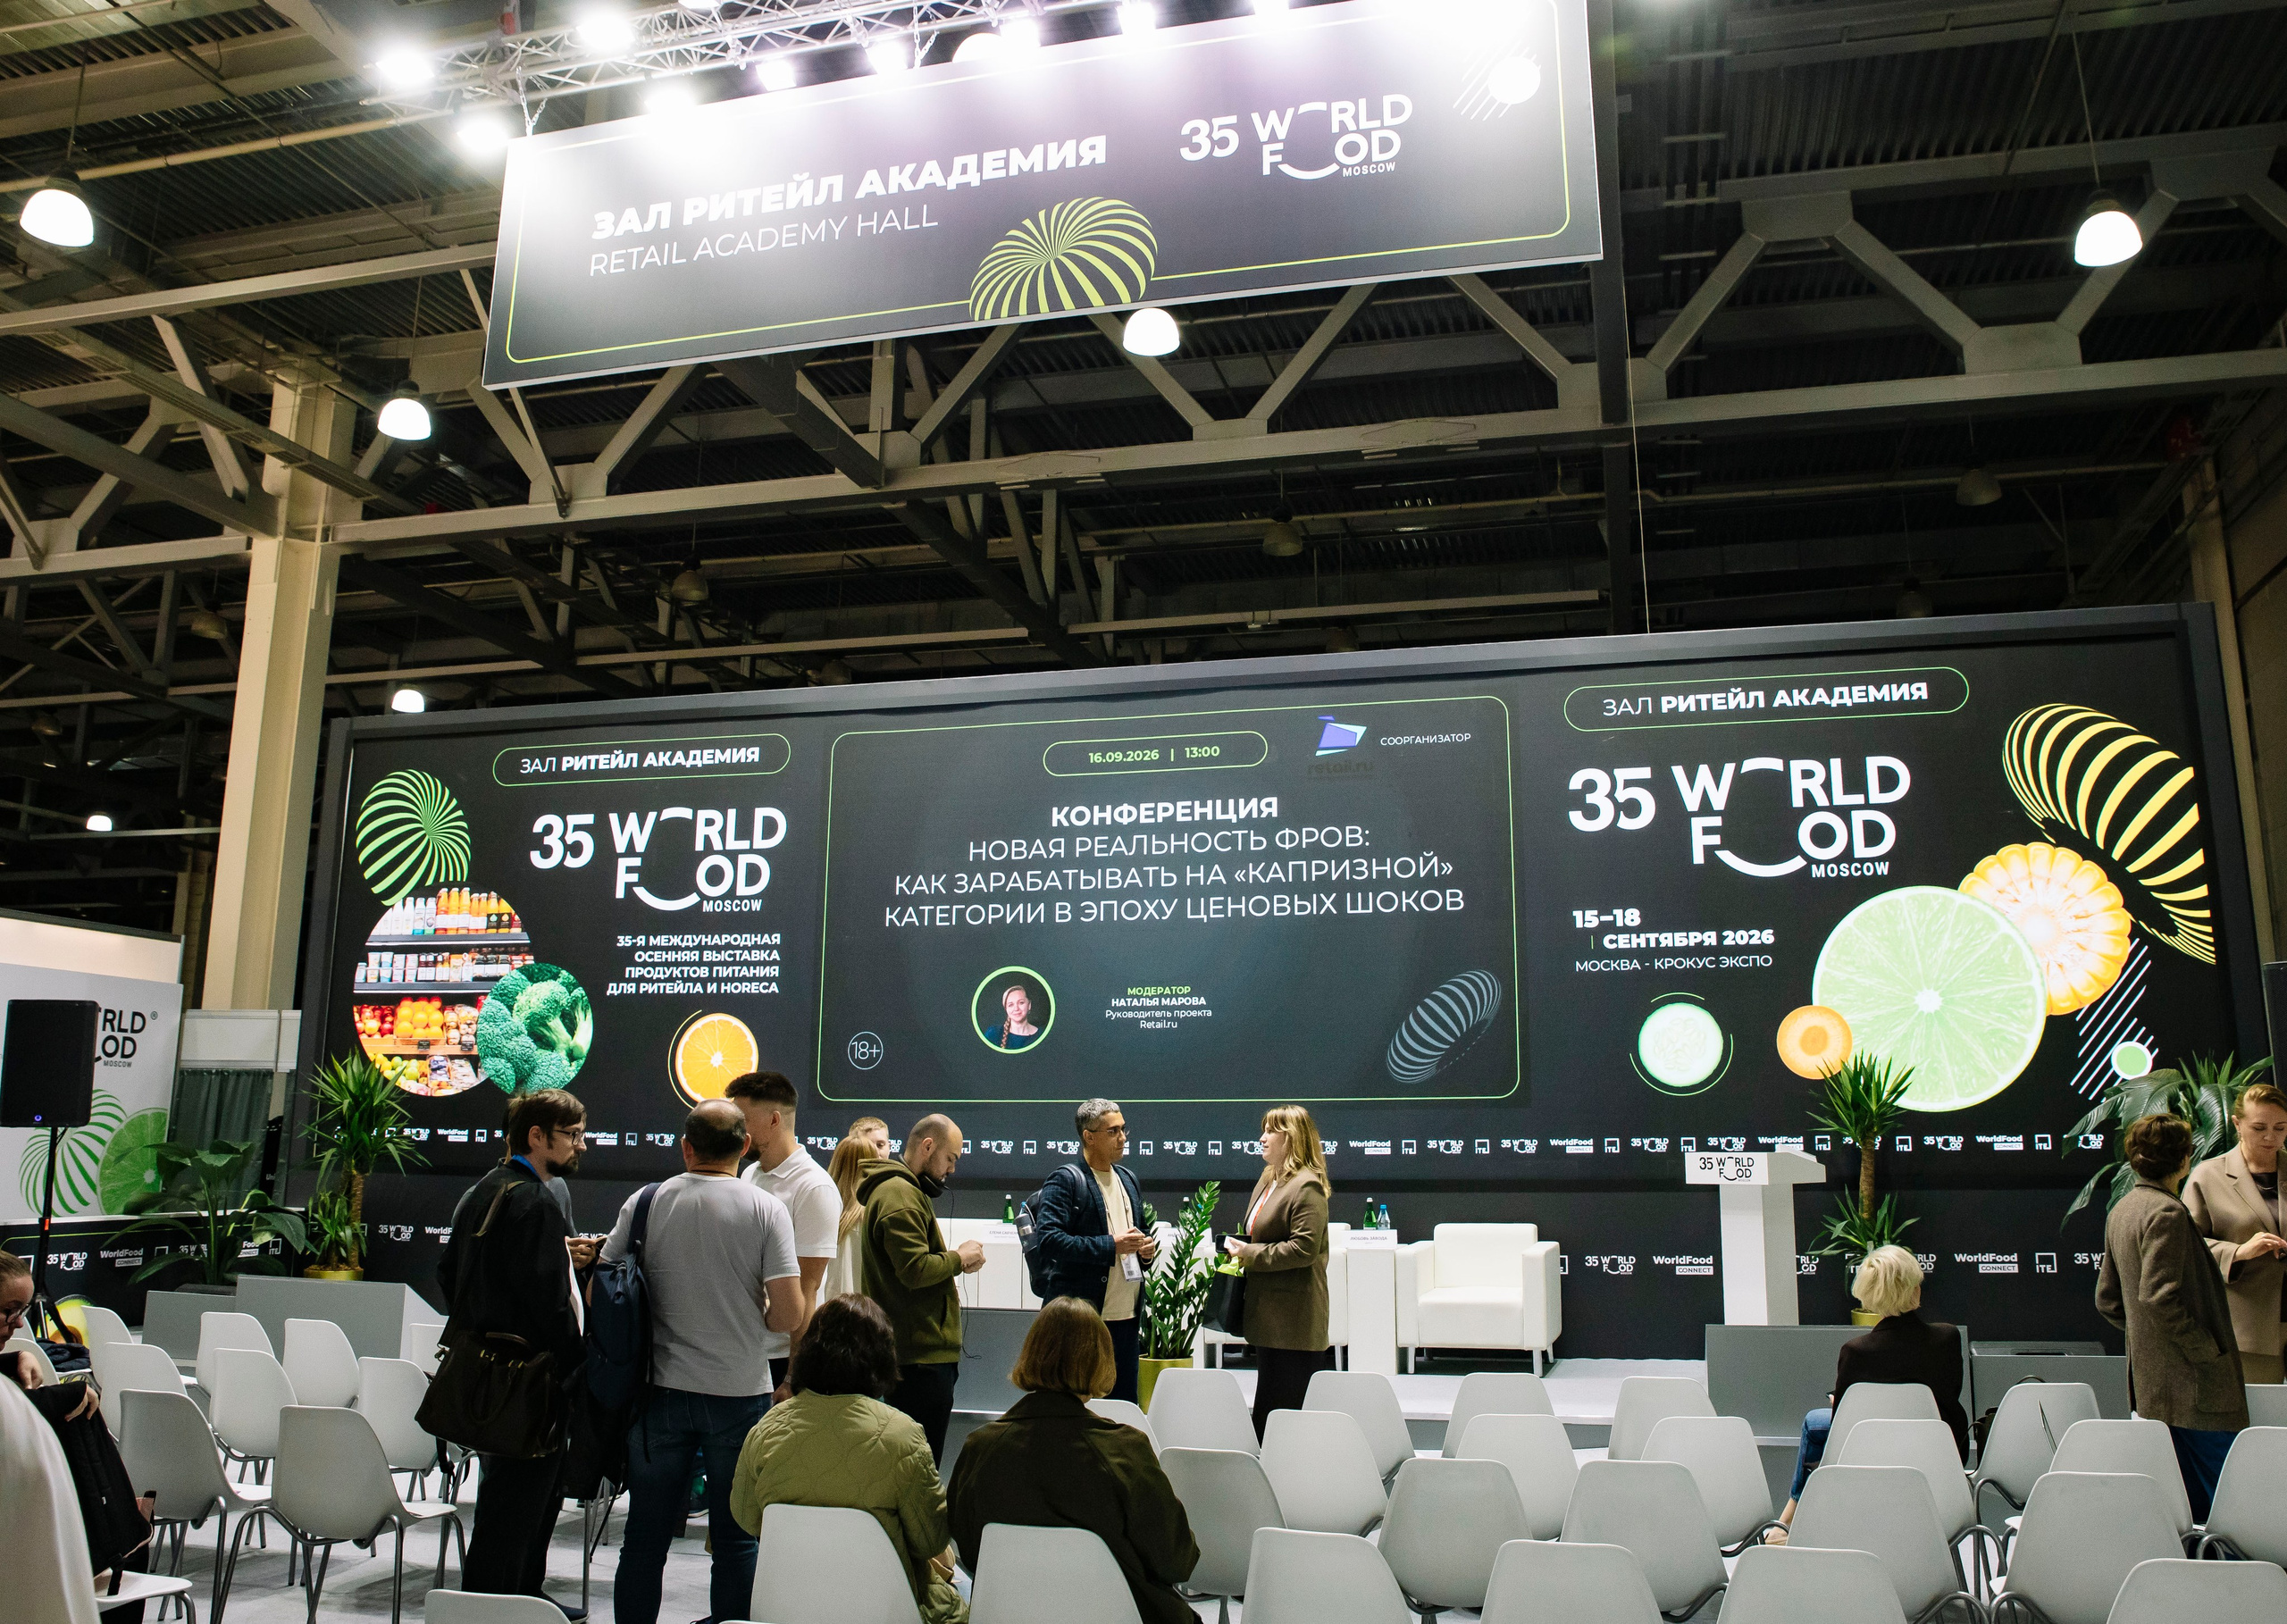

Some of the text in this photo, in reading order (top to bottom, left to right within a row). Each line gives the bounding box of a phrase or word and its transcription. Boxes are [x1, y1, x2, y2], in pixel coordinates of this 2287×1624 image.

[1179, 115, 1239, 162] 35
[1342, 162, 1396, 177] MOSCOW
[591, 135, 1107, 240] ЗАЛ РИТЕЙЛ АКАДЕМИЯ
[589, 204, 938, 277] RETAIL ACADEMY HALL
[1602, 682, 1929, 716] ЗАЛ РИТЕЙЛ АКАДЕМИЯ
[1379, 732, 1472, 748] СООРГАНИЗАТОР
[520, 747, 760, 774] ЗАЛ РИТЕЙЛ АКАДЕМИЯ
[1088, 748, 1160, 764] 16.09.2026
[1185, 745, 1220, 761] 13:00
[1568, 766, 1655, 833] 35
[1051, 796, 1279, 829] КОНФЕРЕНЦИЯ
[530, 813, 595, 870] 35
[968, 824, 1371, 864] НОВАЯ РЕАЛЬНОСТЬ ФРОВ:
[894, 853, 1454, 897] КАК ЗАРАБАТЫВАТЬ НА «КАПРИЗНОЙ»
[1811, 861, 1890, 877] MOSCOW
[702, 899, 763, 913] MOSCOW
[884, 887, 1465, 928] КАТЕГОРИИ В ЭПОХУ ЦЕНОВЫХ ШОКОВ
[616, 933, 781, 948] 35-Я МЕЖДУНАРОДНАЯ
[1602, 928, 1775, 949] СЕНТЯБРЯ 2026
[634, 948, 780, 962] ОСЕННЯЯ ВЫСТАВКА
[1575, 958, 1641, 973] МОСКВА
[1654, 955, 1716, 971] КРОКУС
[1718, 954, 1773, 969] ЭКСПО
[624, 965, 780, 980] ПРОДУКТОВ ПИТАНИЯ
[607, 983, 637, 996] ДЛЯ
[639, 980, 703, 995] РИТЕЙЛА
[707, 983, 717, 994] И
[1127, 984, 1192, 998] МОДЕРАТОР
[1110, 996, 1206, 1008] НАТАЛЬЯ МАРОВА
[101, 1008, 147, 1034] RLD
[1105, 1007, 1212, 1020] Руководитель проекта
[1139, 1018, 1178, 1029] Retail.ru
[850, 1041, 881, 1060] 18+
[1549, 1138, 1593, 1146] WorldFood
[1699, 1158, 1713, 1170] 35
[47, 1253, 59, 1265] 35
[100, 1248, 144, 1259] WorldFood
[1585, 1256, 1599, 1267] 35
[1653, 1256, 1713, 1264] WorldFood
[1955, 1253, 2017, 1261] WorldFood
[2073, 1253, 2088, 1264] 35
